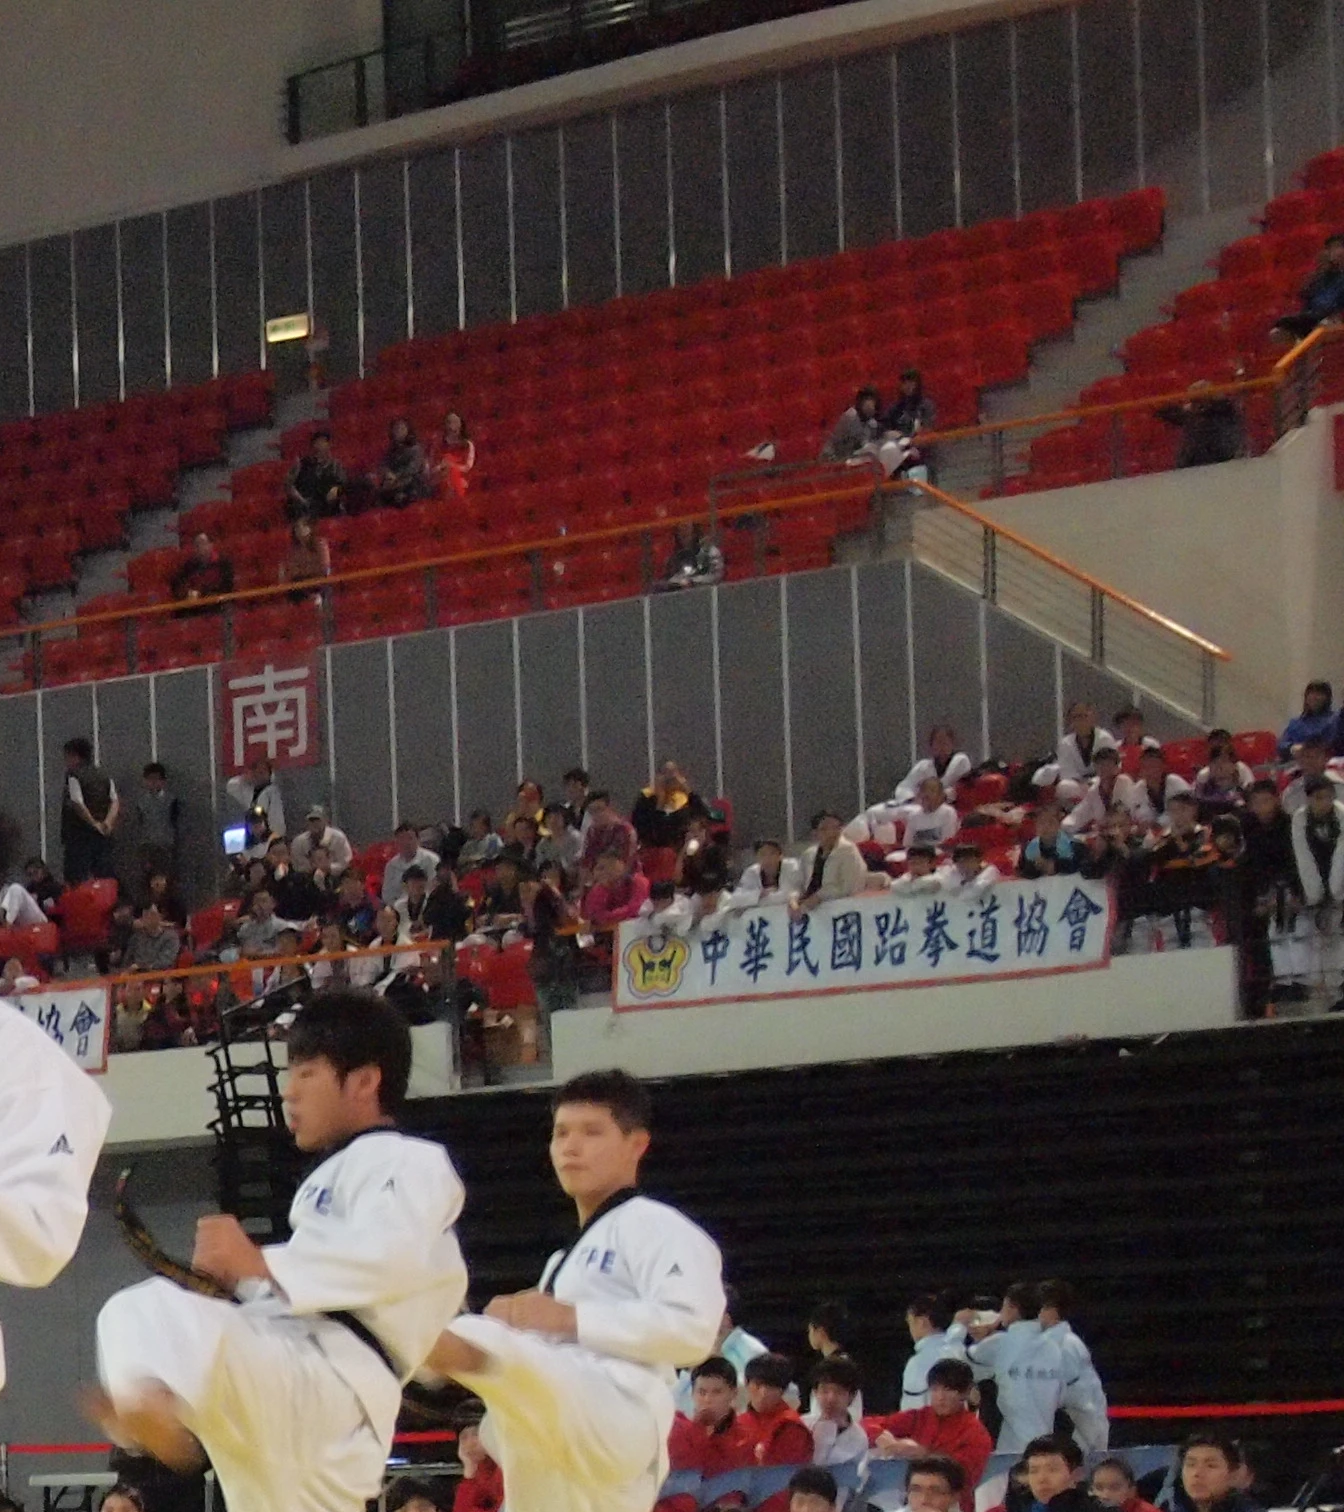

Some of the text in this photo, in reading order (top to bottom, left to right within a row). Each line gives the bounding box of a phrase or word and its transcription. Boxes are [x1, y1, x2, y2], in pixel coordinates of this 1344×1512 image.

[228, 664, 310, 767] 南
[700, 886, 1103, 986] 中華民國跆拳道協會
